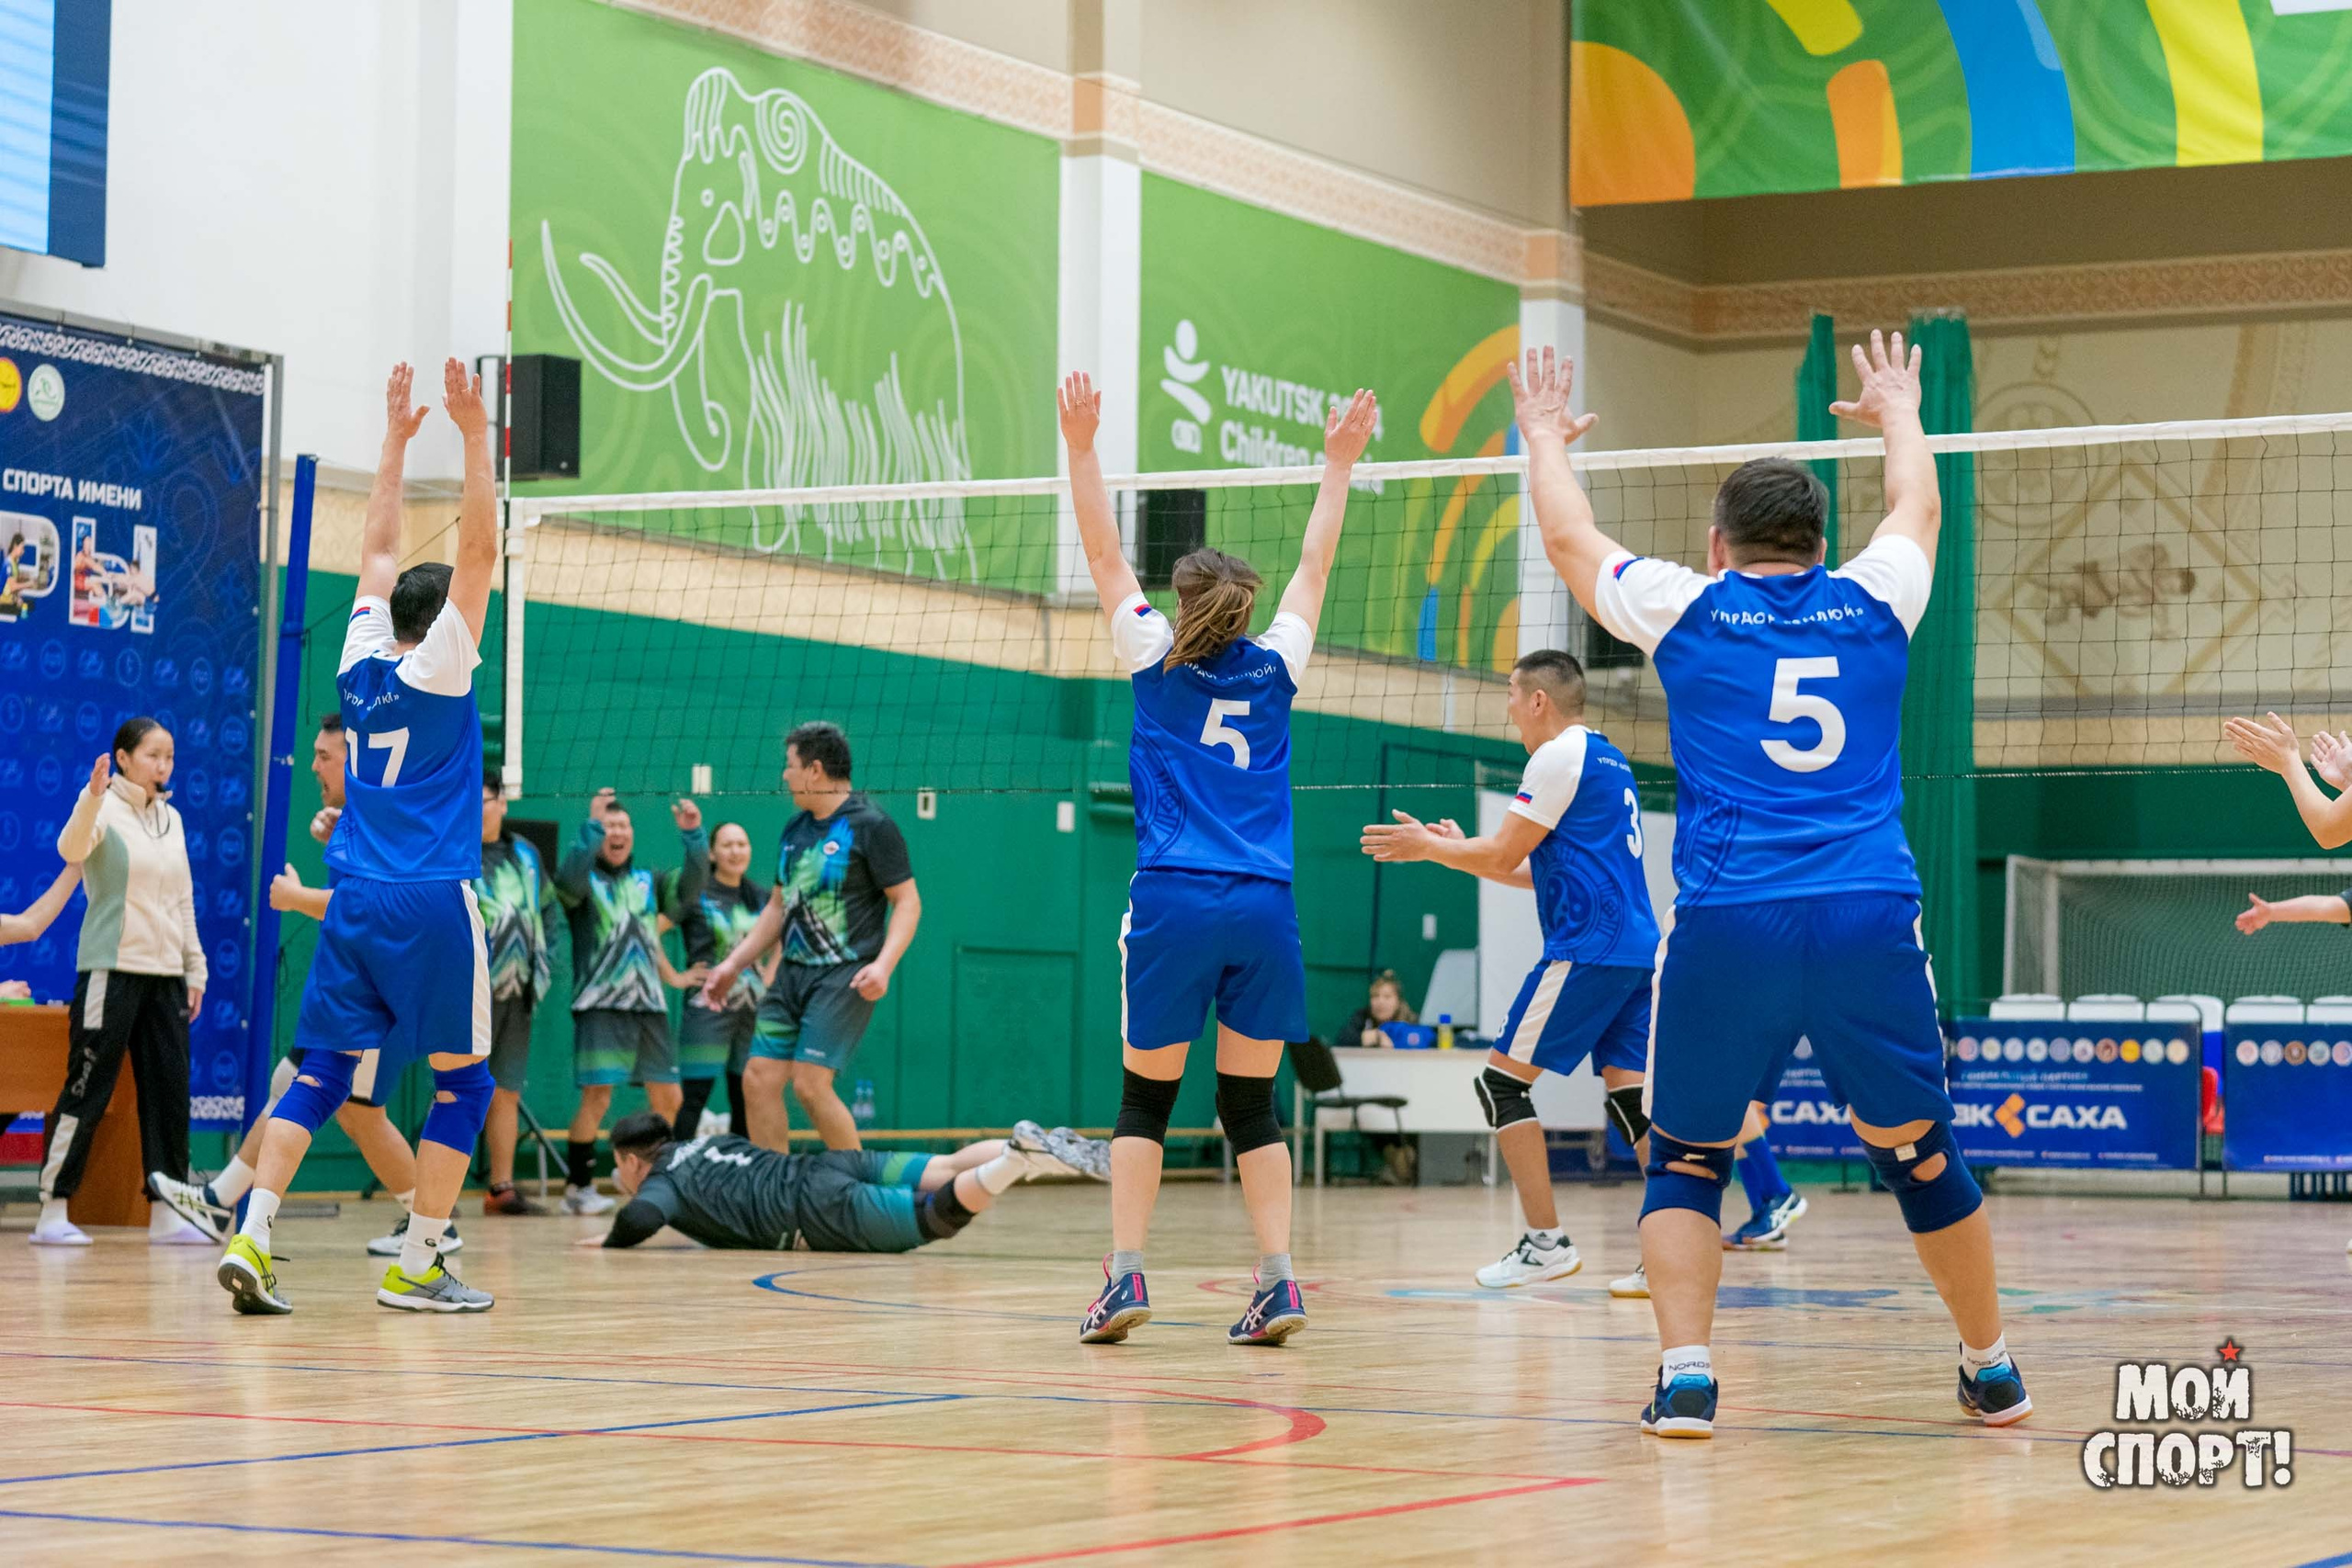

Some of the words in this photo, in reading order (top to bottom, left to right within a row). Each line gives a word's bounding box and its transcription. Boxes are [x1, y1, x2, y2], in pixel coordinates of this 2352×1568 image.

[1221, 366, 1325, 428] YAKUTSK
[3, 468, 74, 501] СПОРТА
[78, 479, 142, 511] ИМЕНИ
[1200, 698, 1250, 770] 5
[1759, 656, 1846, 773] 5
[345, 727, 410, 788] 17
[1624, 787, 1643, 859] 3
[2026, 1104, 2128, 1130] САХА
